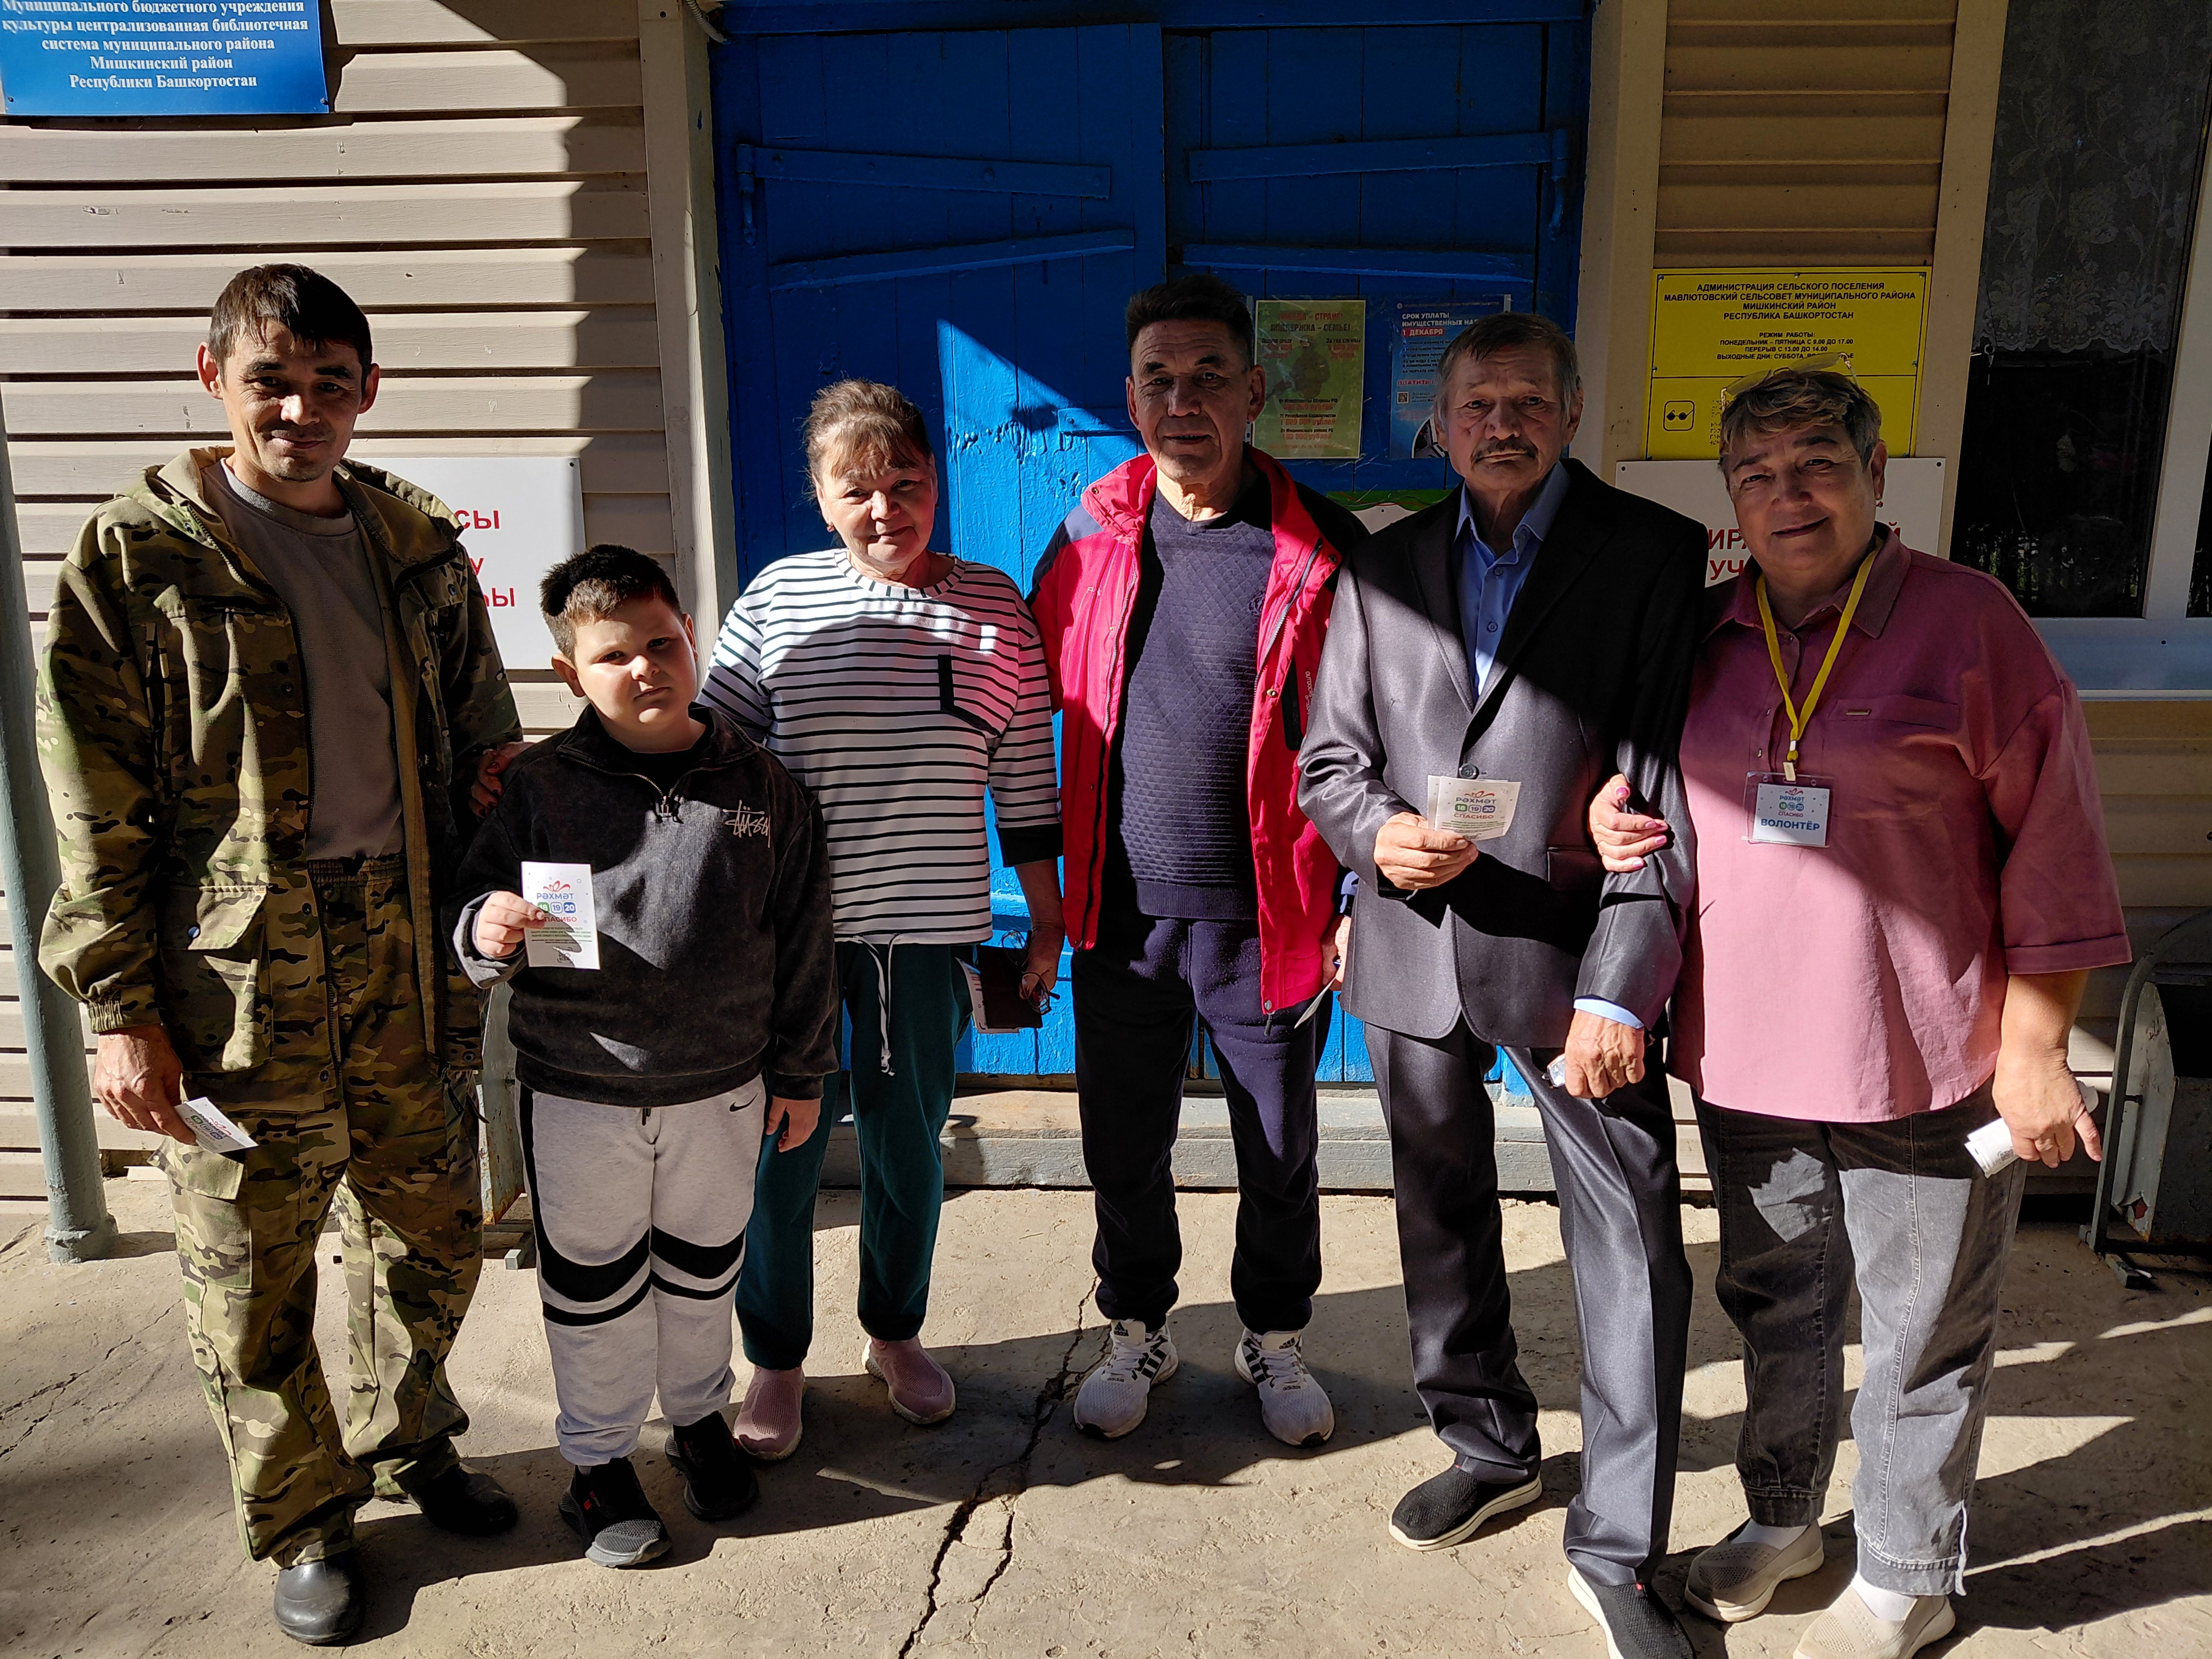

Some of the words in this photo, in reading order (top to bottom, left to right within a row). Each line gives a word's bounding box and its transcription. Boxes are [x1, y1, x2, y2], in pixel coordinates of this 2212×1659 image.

[2, 0, 128, 15] Муниципального
[132, 1, 217, 15] бюджетного
[220, 2, 304, 16] учреждения
[2, 20, 73, 34] культуры
[76, 20, 209, 35] централизованная
[212, 18, 308, 31] библиотечная
[42, 40, 99, 50] система
[102, 41, 222, 54] муниципального
[226, 37, 275, 53] района
[89, 56, 188, 69] Мишкинский
[191, 56, 233, 72] район
[69, 74, 152, 91] Республики
[156, 75, 257, 90] Башкортостан
[1696, 284, 1774, 292] АДМИНИСТРАЦИЯ
[1664, 292, 1738, 301] МАВЛЮТОВСКИЙ
[1795, 292, 1878, 300] МУНИЦИПАЛЬНОГО
[1881, 290, 1915, 299] РАЙОНА
[1743, 301, 1804, 310] МИШКИНСКИЙ
[1806, 301, 1836, 310] РАЙОН
[1409, 329, 1443, 337] ДЕКАБРЯ
[1760, 819, 1820, 831] ВОЛОНТЁР
